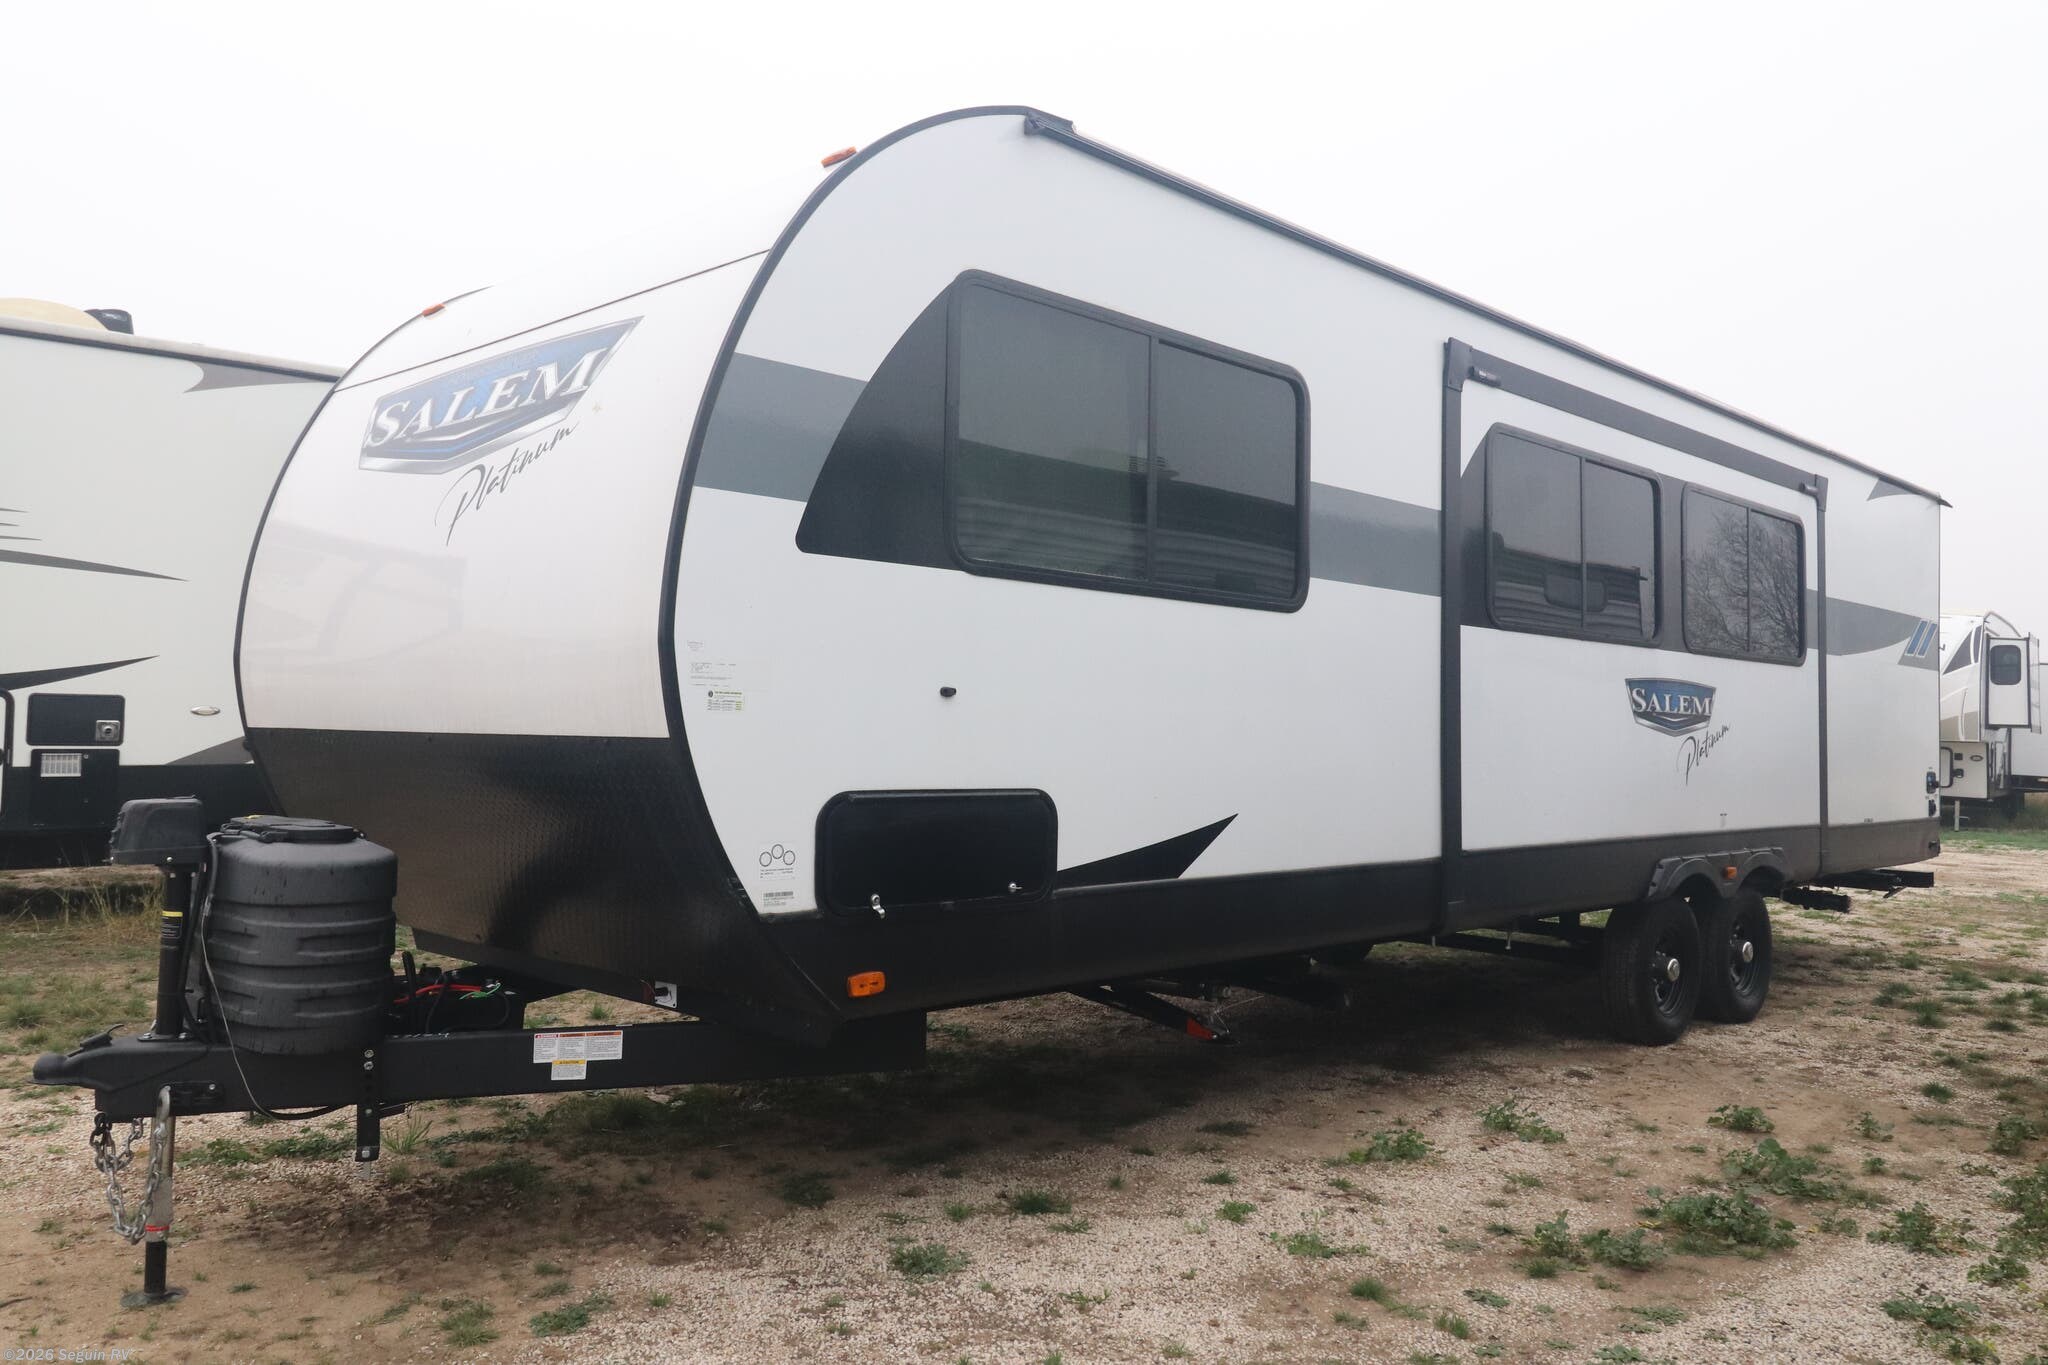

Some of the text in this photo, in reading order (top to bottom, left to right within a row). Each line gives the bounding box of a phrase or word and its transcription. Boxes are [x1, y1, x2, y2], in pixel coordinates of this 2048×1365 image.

[366, 347, 609, 447] SALEM
[435, 421, 580, 547] Platinum
[1632, 687, 1712, 716] SALEM
[1676, 722, 1734, 785] Platinum
